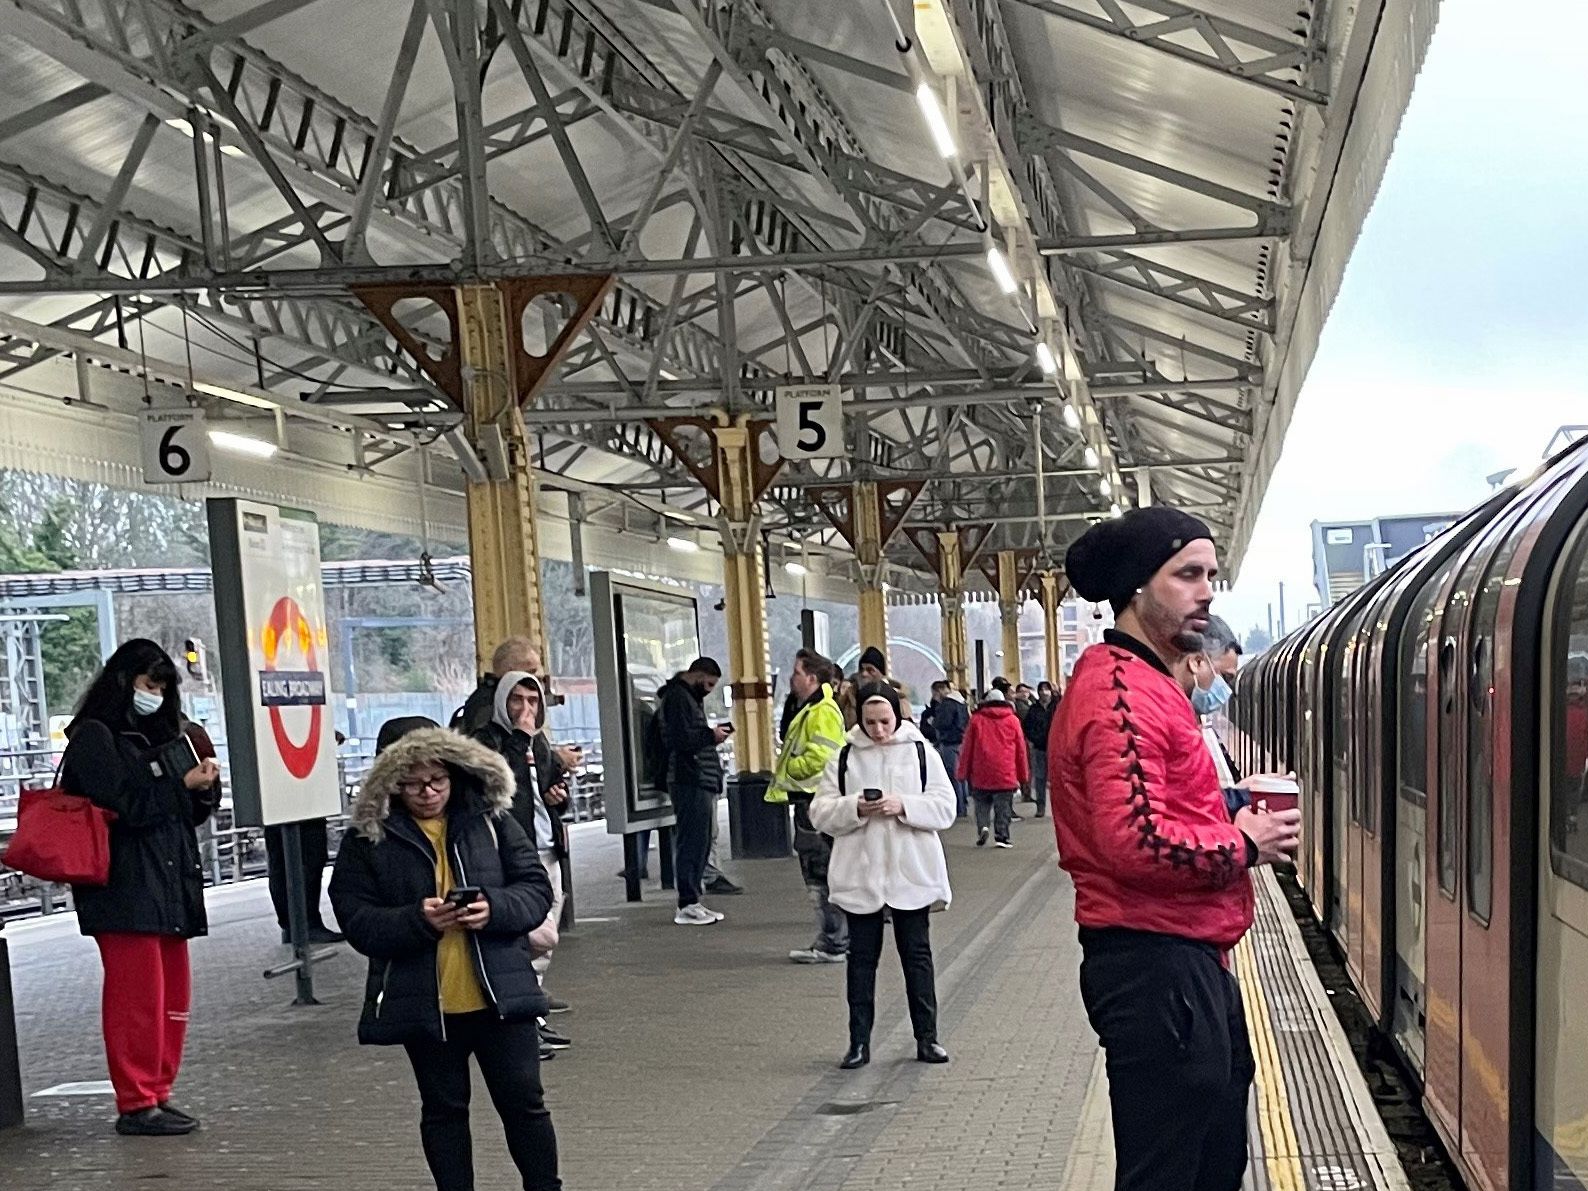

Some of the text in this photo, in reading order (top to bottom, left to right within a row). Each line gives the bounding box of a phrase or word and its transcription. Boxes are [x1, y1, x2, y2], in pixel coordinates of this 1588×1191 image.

[784, 389, 830, 398] PLATFORM
[147, 414, 193, 422] PLATFORM
[797, 401, 826, 452] 5
[159, 424, 190, 476] 6
